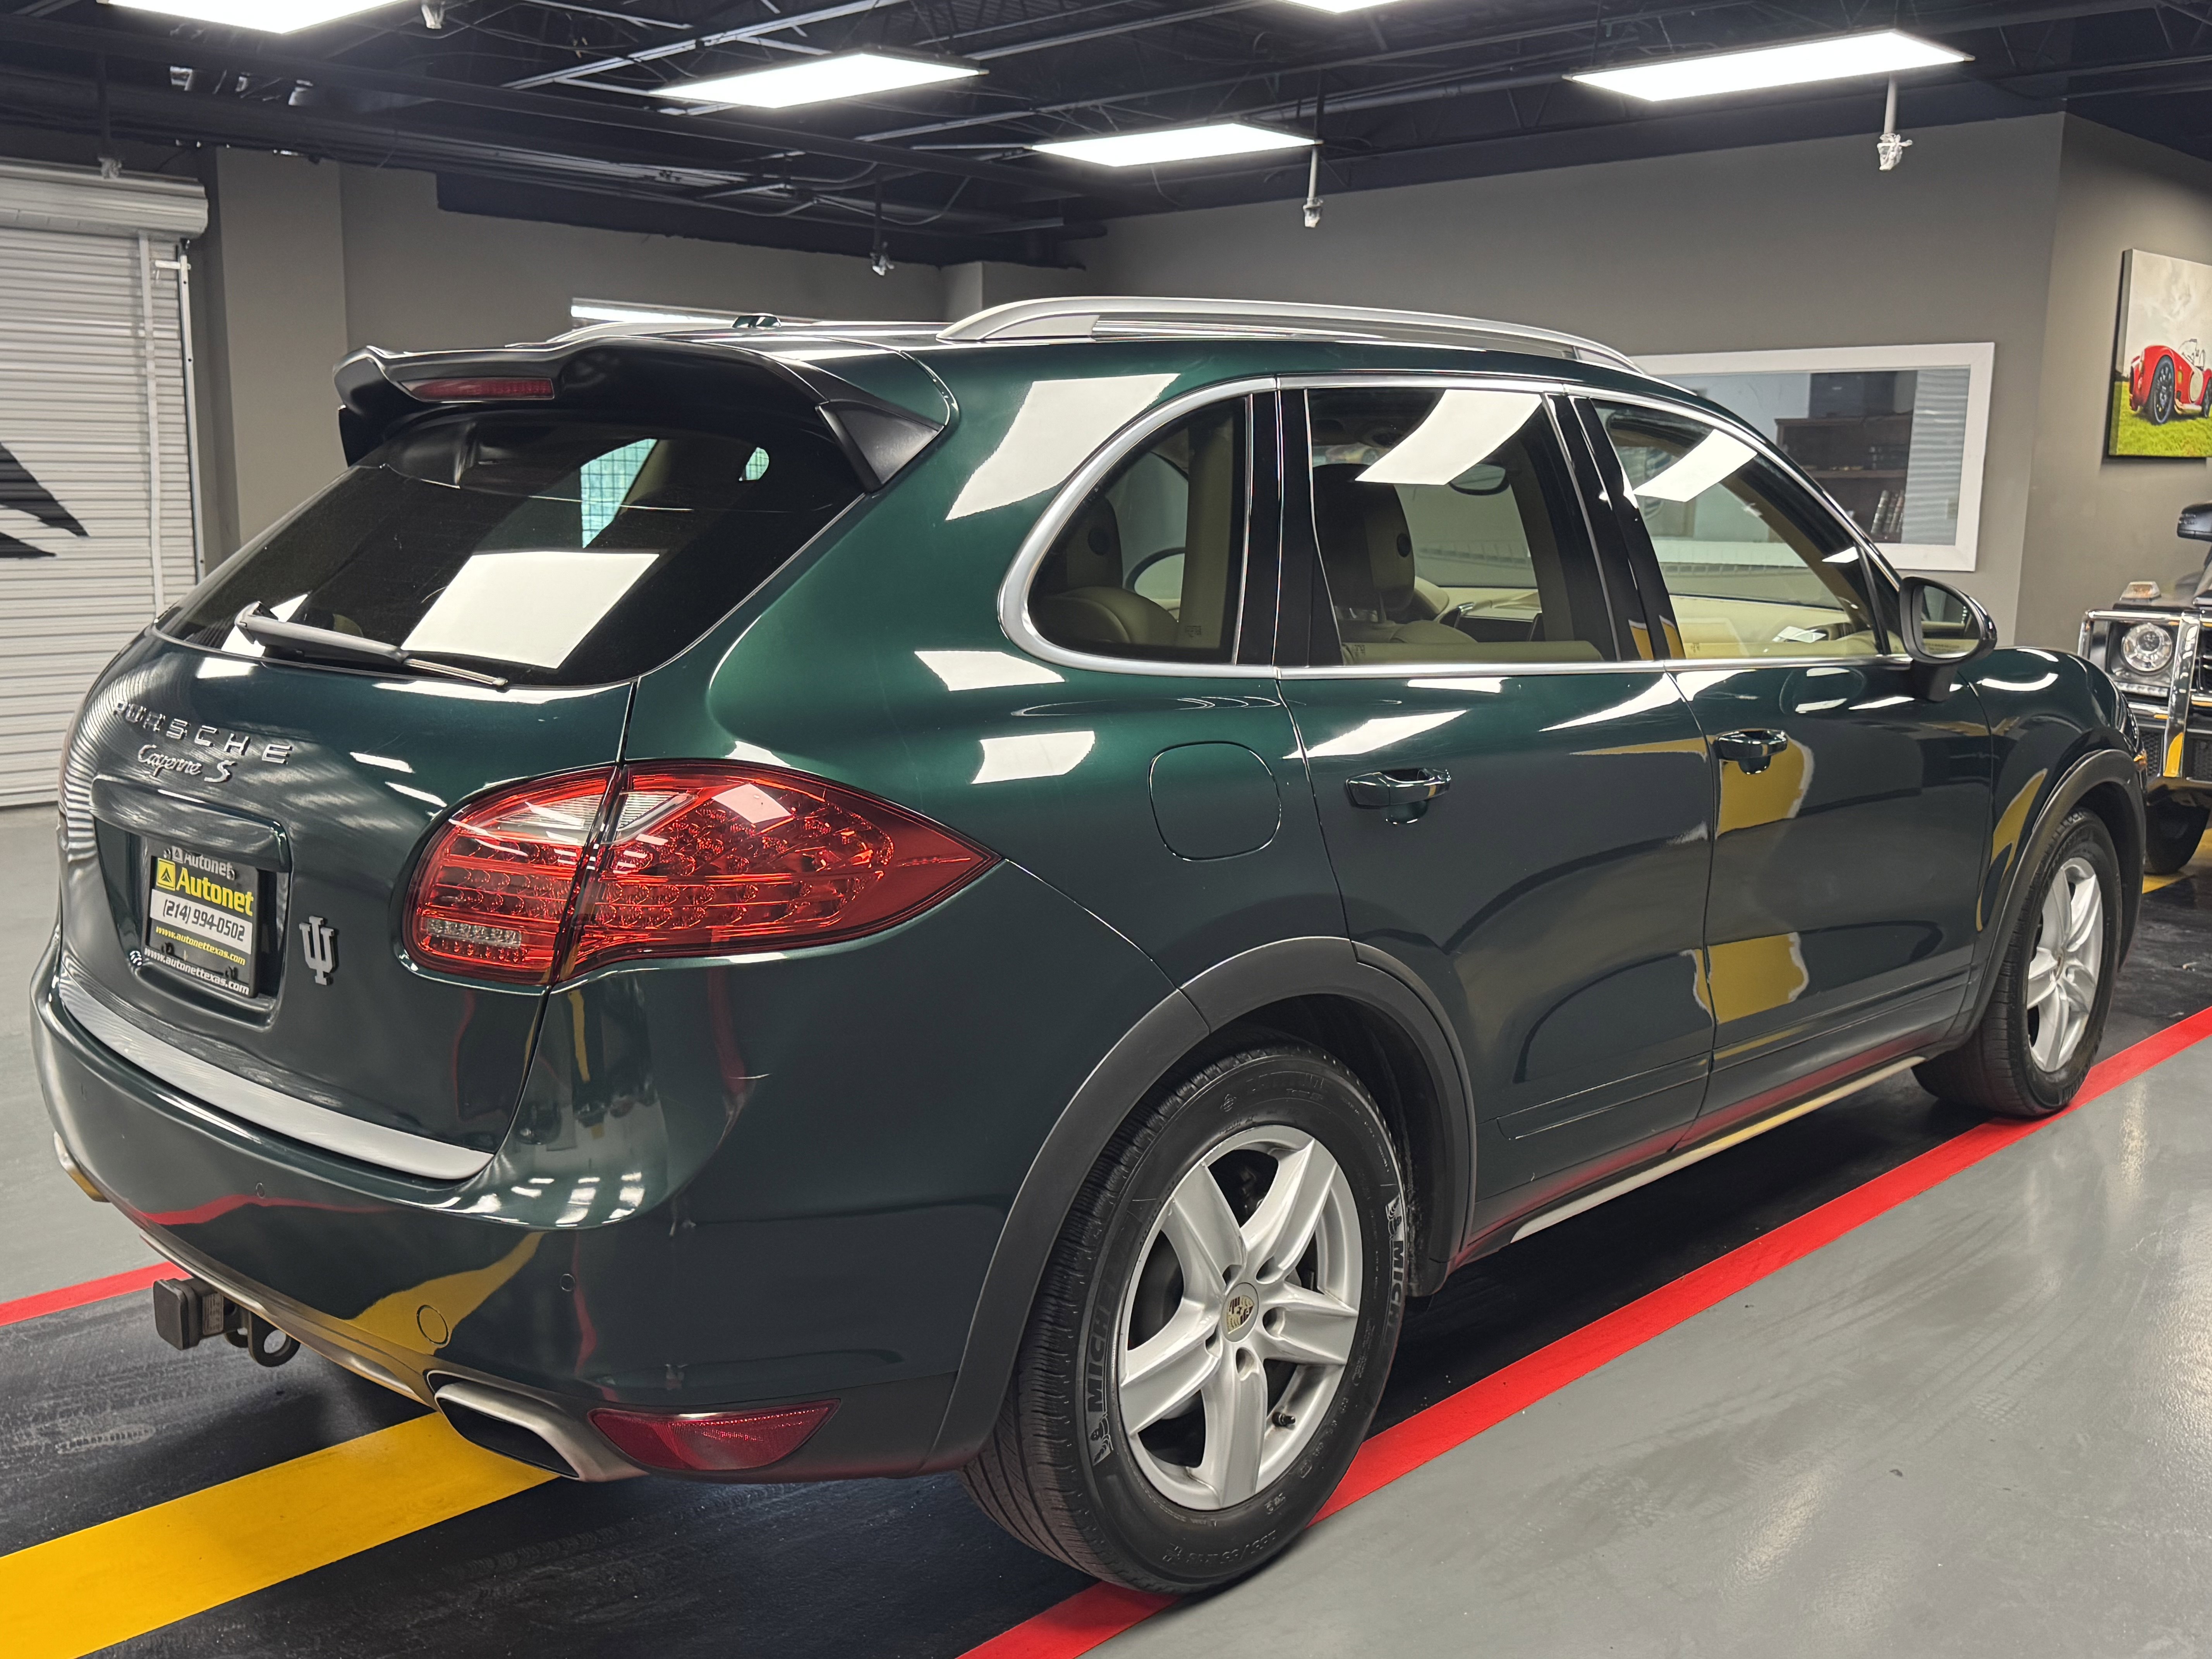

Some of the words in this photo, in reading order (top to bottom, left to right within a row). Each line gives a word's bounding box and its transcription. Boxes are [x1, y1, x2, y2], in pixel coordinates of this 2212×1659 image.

[113, 699, 293, 764] PORSCHE
[138, 744, 203, 776] Cayenne
[204, 760, 237, 783] S
[184, 852, 234, 879] Autonet
[176, 867, 254, 917] Autonet
[163, 899, 191, 924] (214)
[191, 908, 245, 942] 994-0502
[156, 926, 246, 966] www.autonettexas.com
[144, 947, 249, 995] www.autonettexas.com
